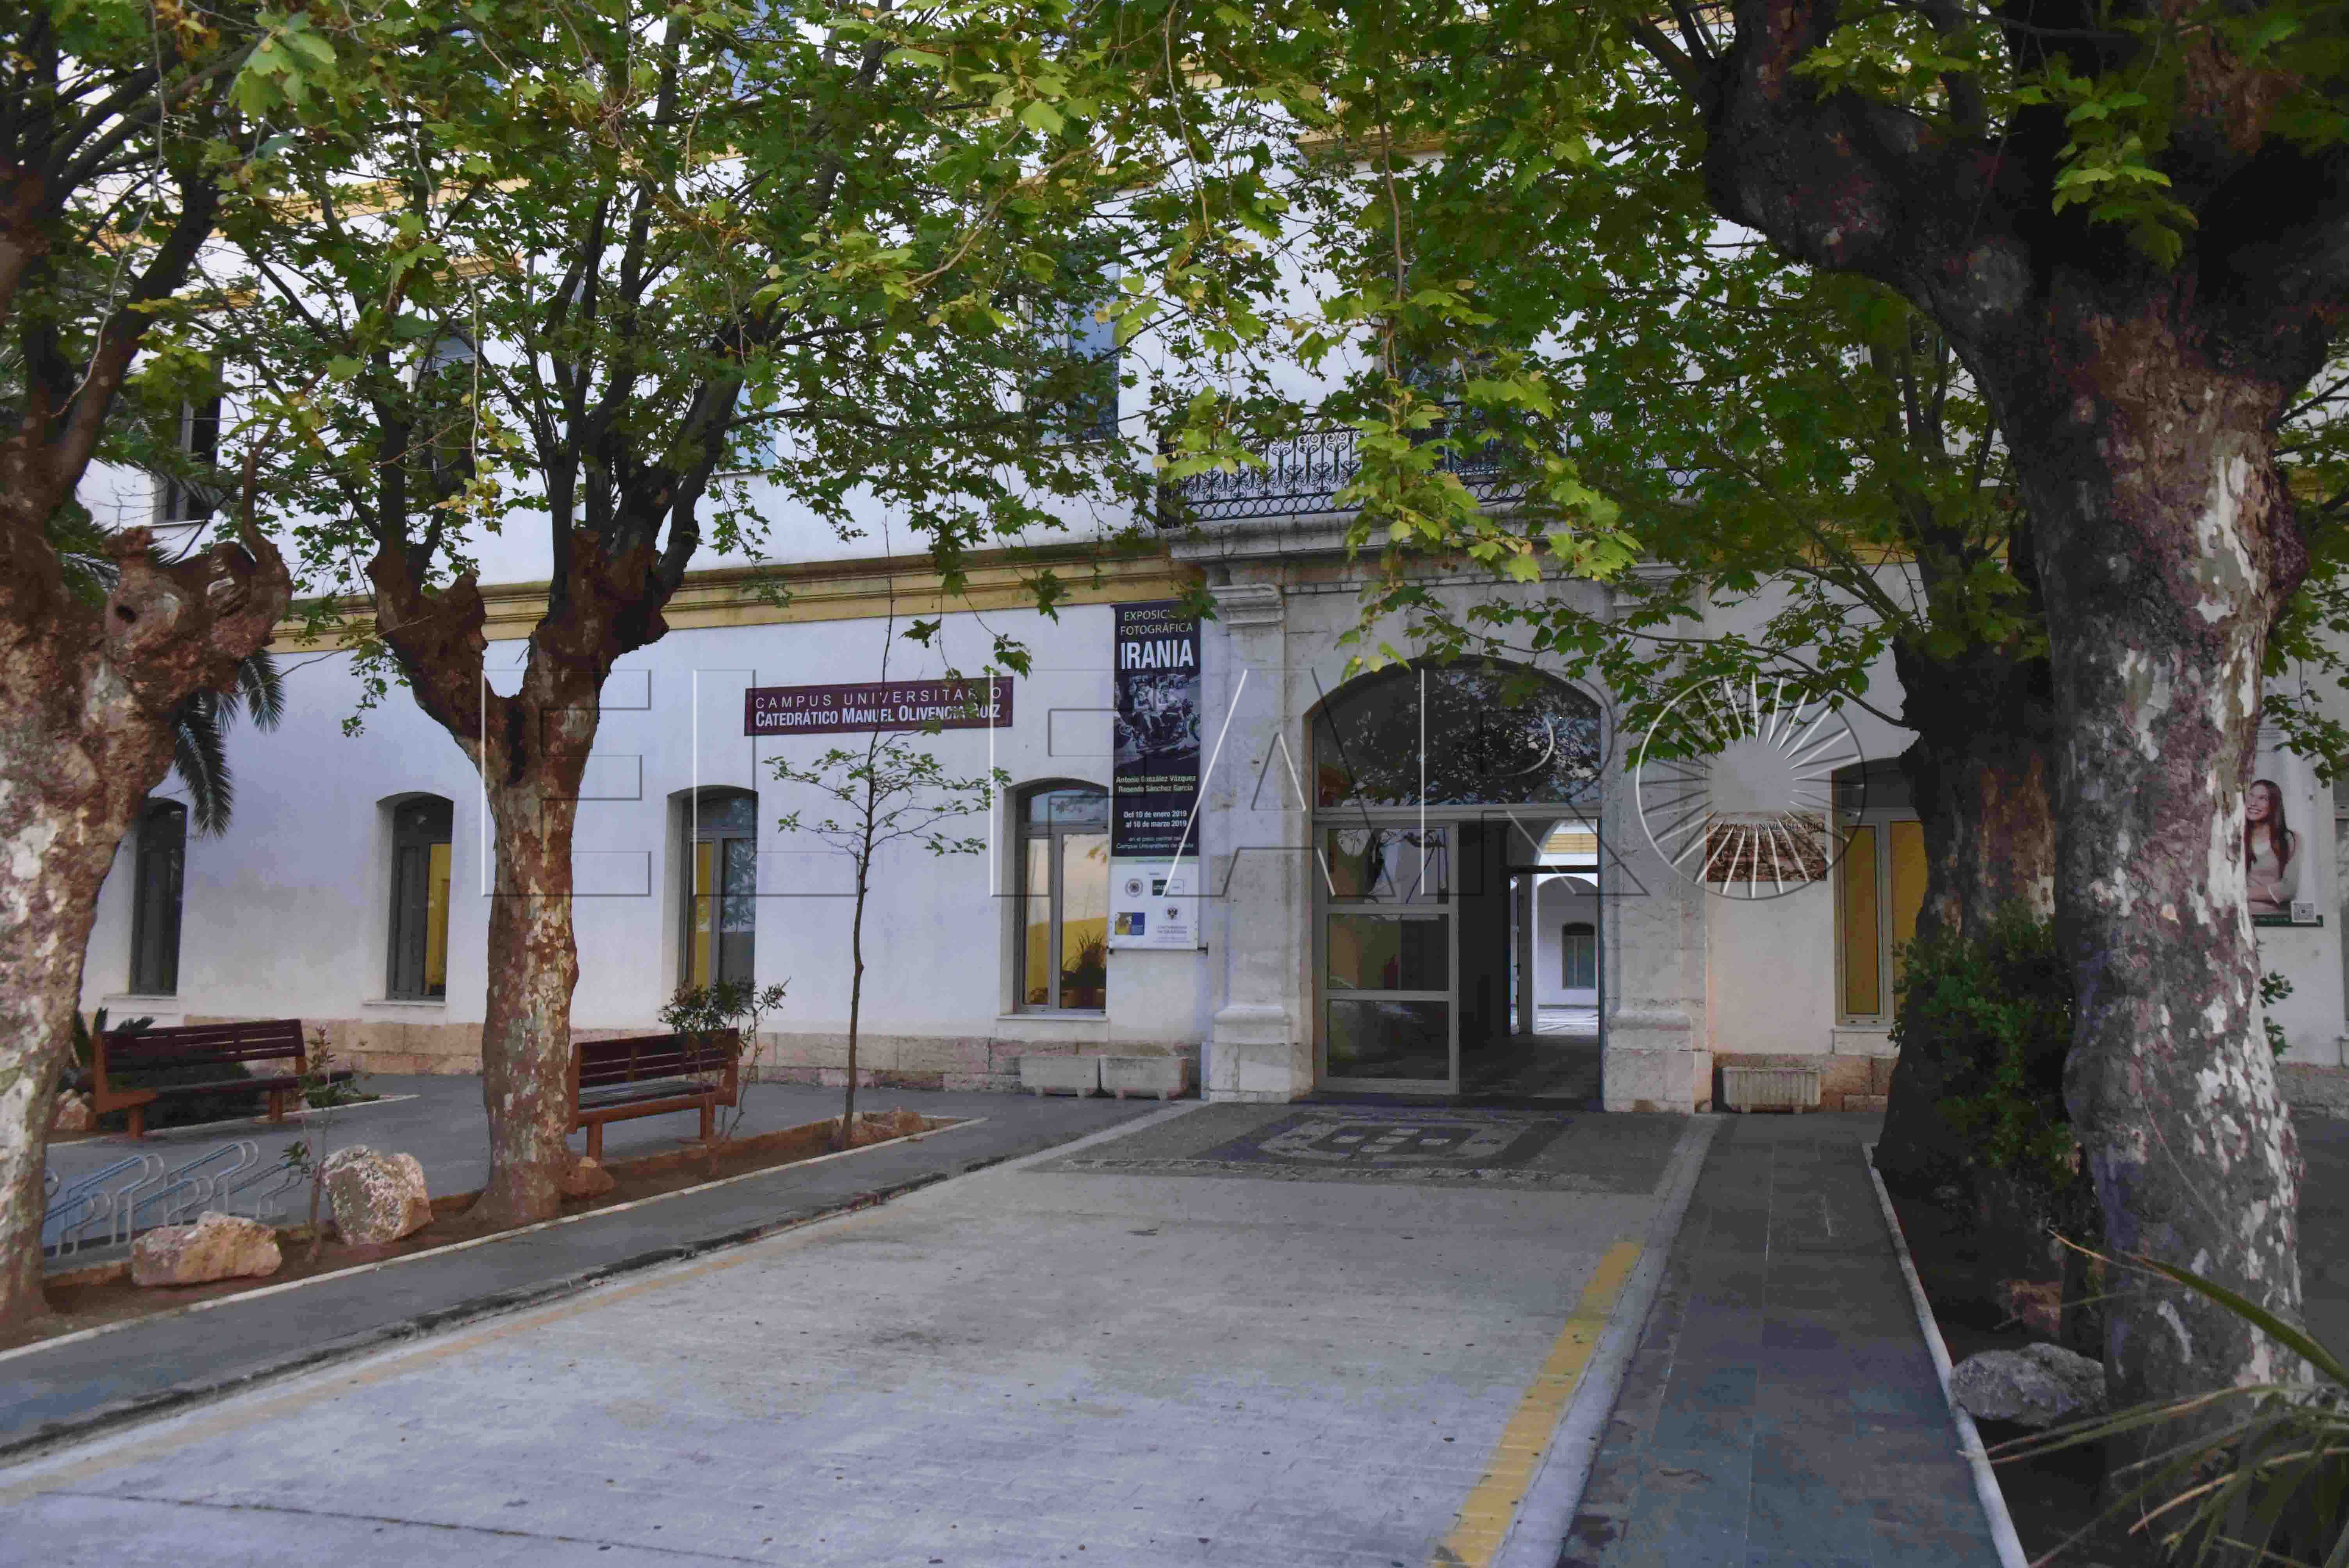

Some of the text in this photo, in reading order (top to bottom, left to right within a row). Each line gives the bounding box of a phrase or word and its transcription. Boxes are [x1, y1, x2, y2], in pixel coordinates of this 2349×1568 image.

[1124, 609, 1188, 622] EXPOSIC
[1120, 622, 1193, 635] FOTOGRÁFICA
[1121, 639, 1194, 669] IRANIA
[756, 687, 1002, 709] CAMPUS UNIVERSITARO
[756, 709, 838, 727] CATEDRÁTICO
[842, 707, 895, 723] MANUEL
